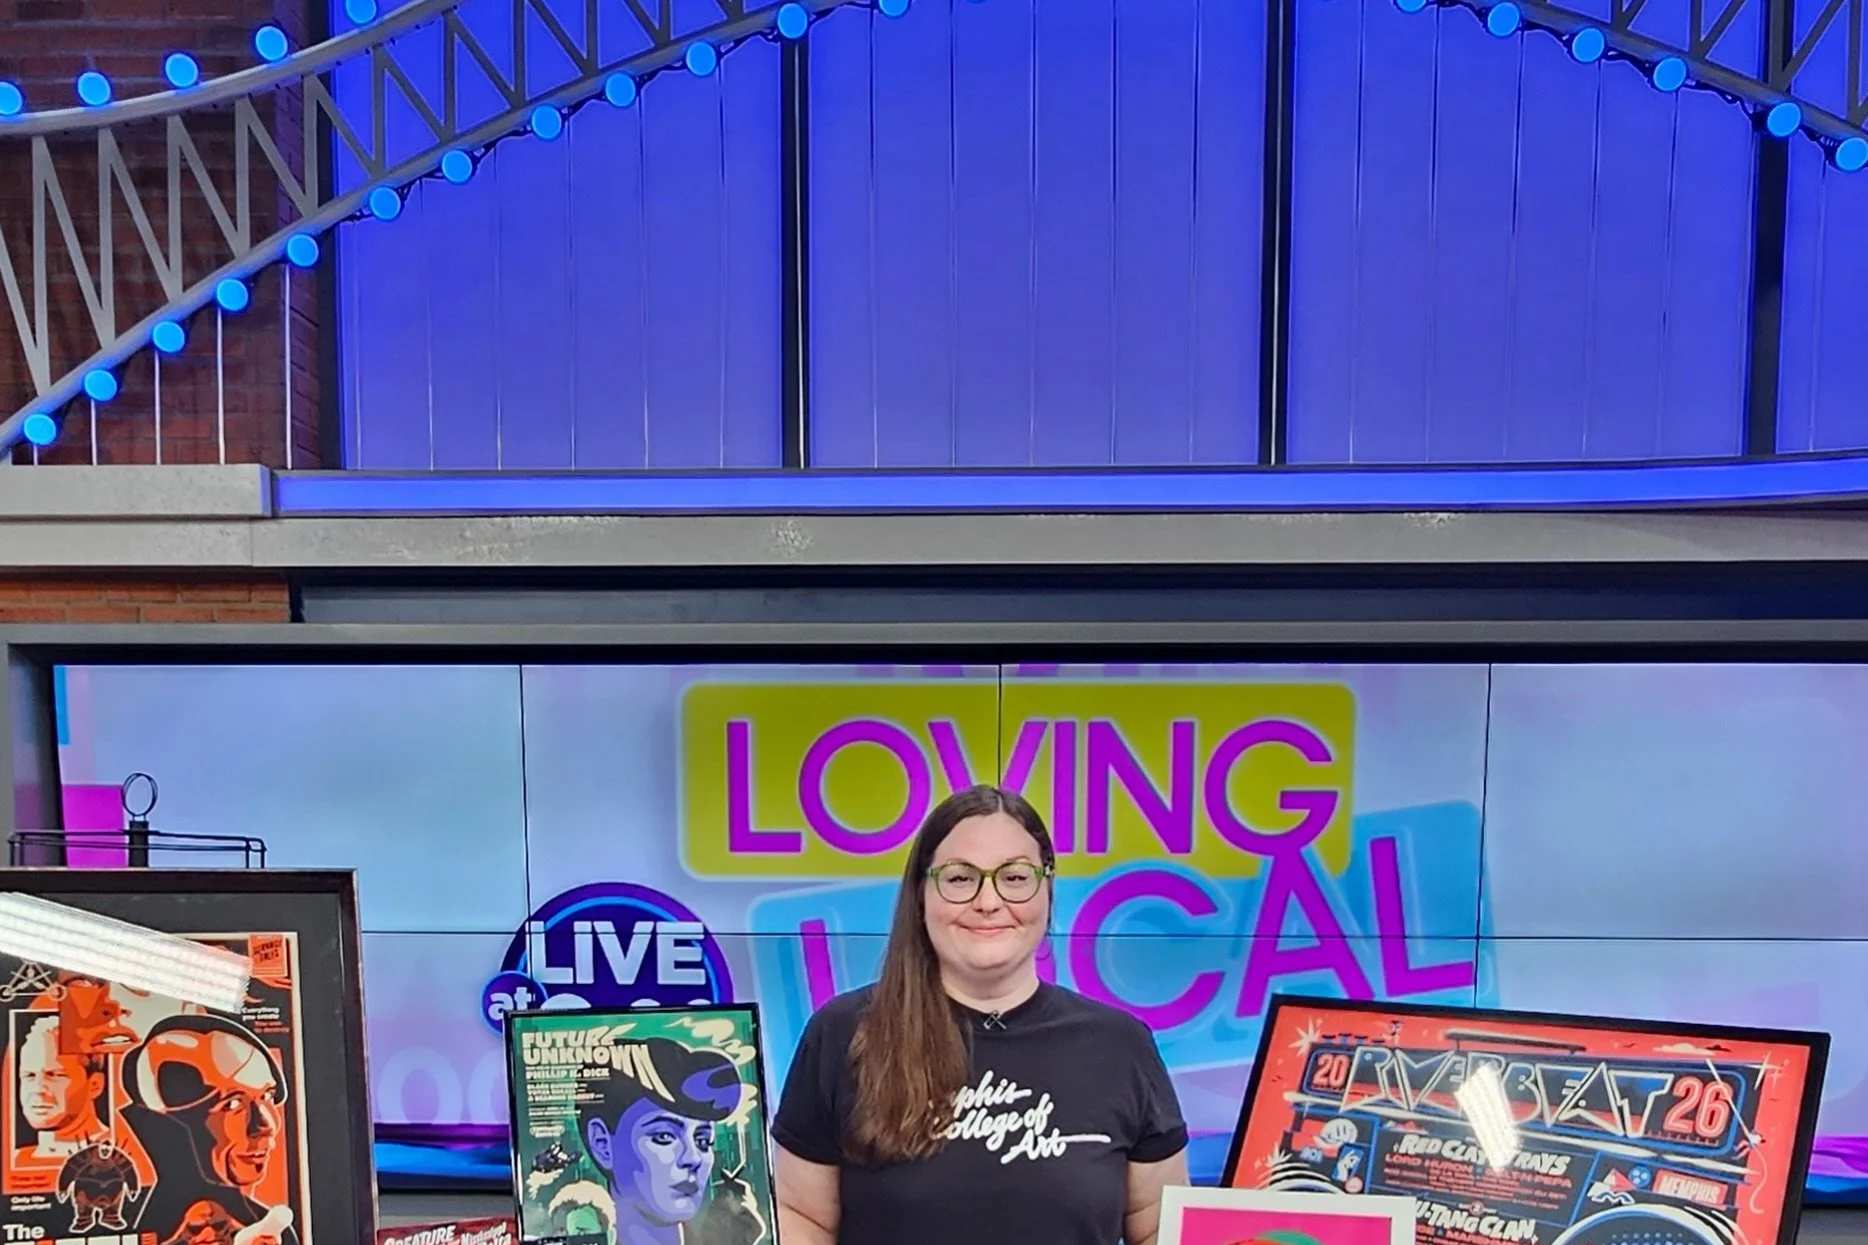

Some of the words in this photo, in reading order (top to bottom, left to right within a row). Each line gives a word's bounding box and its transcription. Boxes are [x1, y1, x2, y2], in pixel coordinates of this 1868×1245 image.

[727, 720, 1340, 856] LOVING
[525, 921, 706, 985] LIVE
[801, 837, 1476, 1031] LCAL
[488, 987, 535, 1020] at
[522, 1023, 637, 1048] FUTURE
[522, 1044, 676, 1102] UNKNOWN
[583, 1067, 610, 1078] DICK
[953, 1070, 1032, 1118] phis
[1023, 1093, 1054, 1135] of
[1311, 1054, 1348, 1086] 20
[1663, 1076, 1733, 1137] 26
[1000, 1128, 1111, 1165] Art
[1398, 1134, 1443, 1155] RED
[1442, 1137, 1486, 1164] CLAY
[1510, 1150, 1572, 1176] RAYS
[1661, 1174, 1719, 1204] MEMPHIS
[2, 1224, 45, 1240] The
[1415, 1200, 1480, 1233] U-TANG
[1479, 1216, 1536, 1241] CLAN
